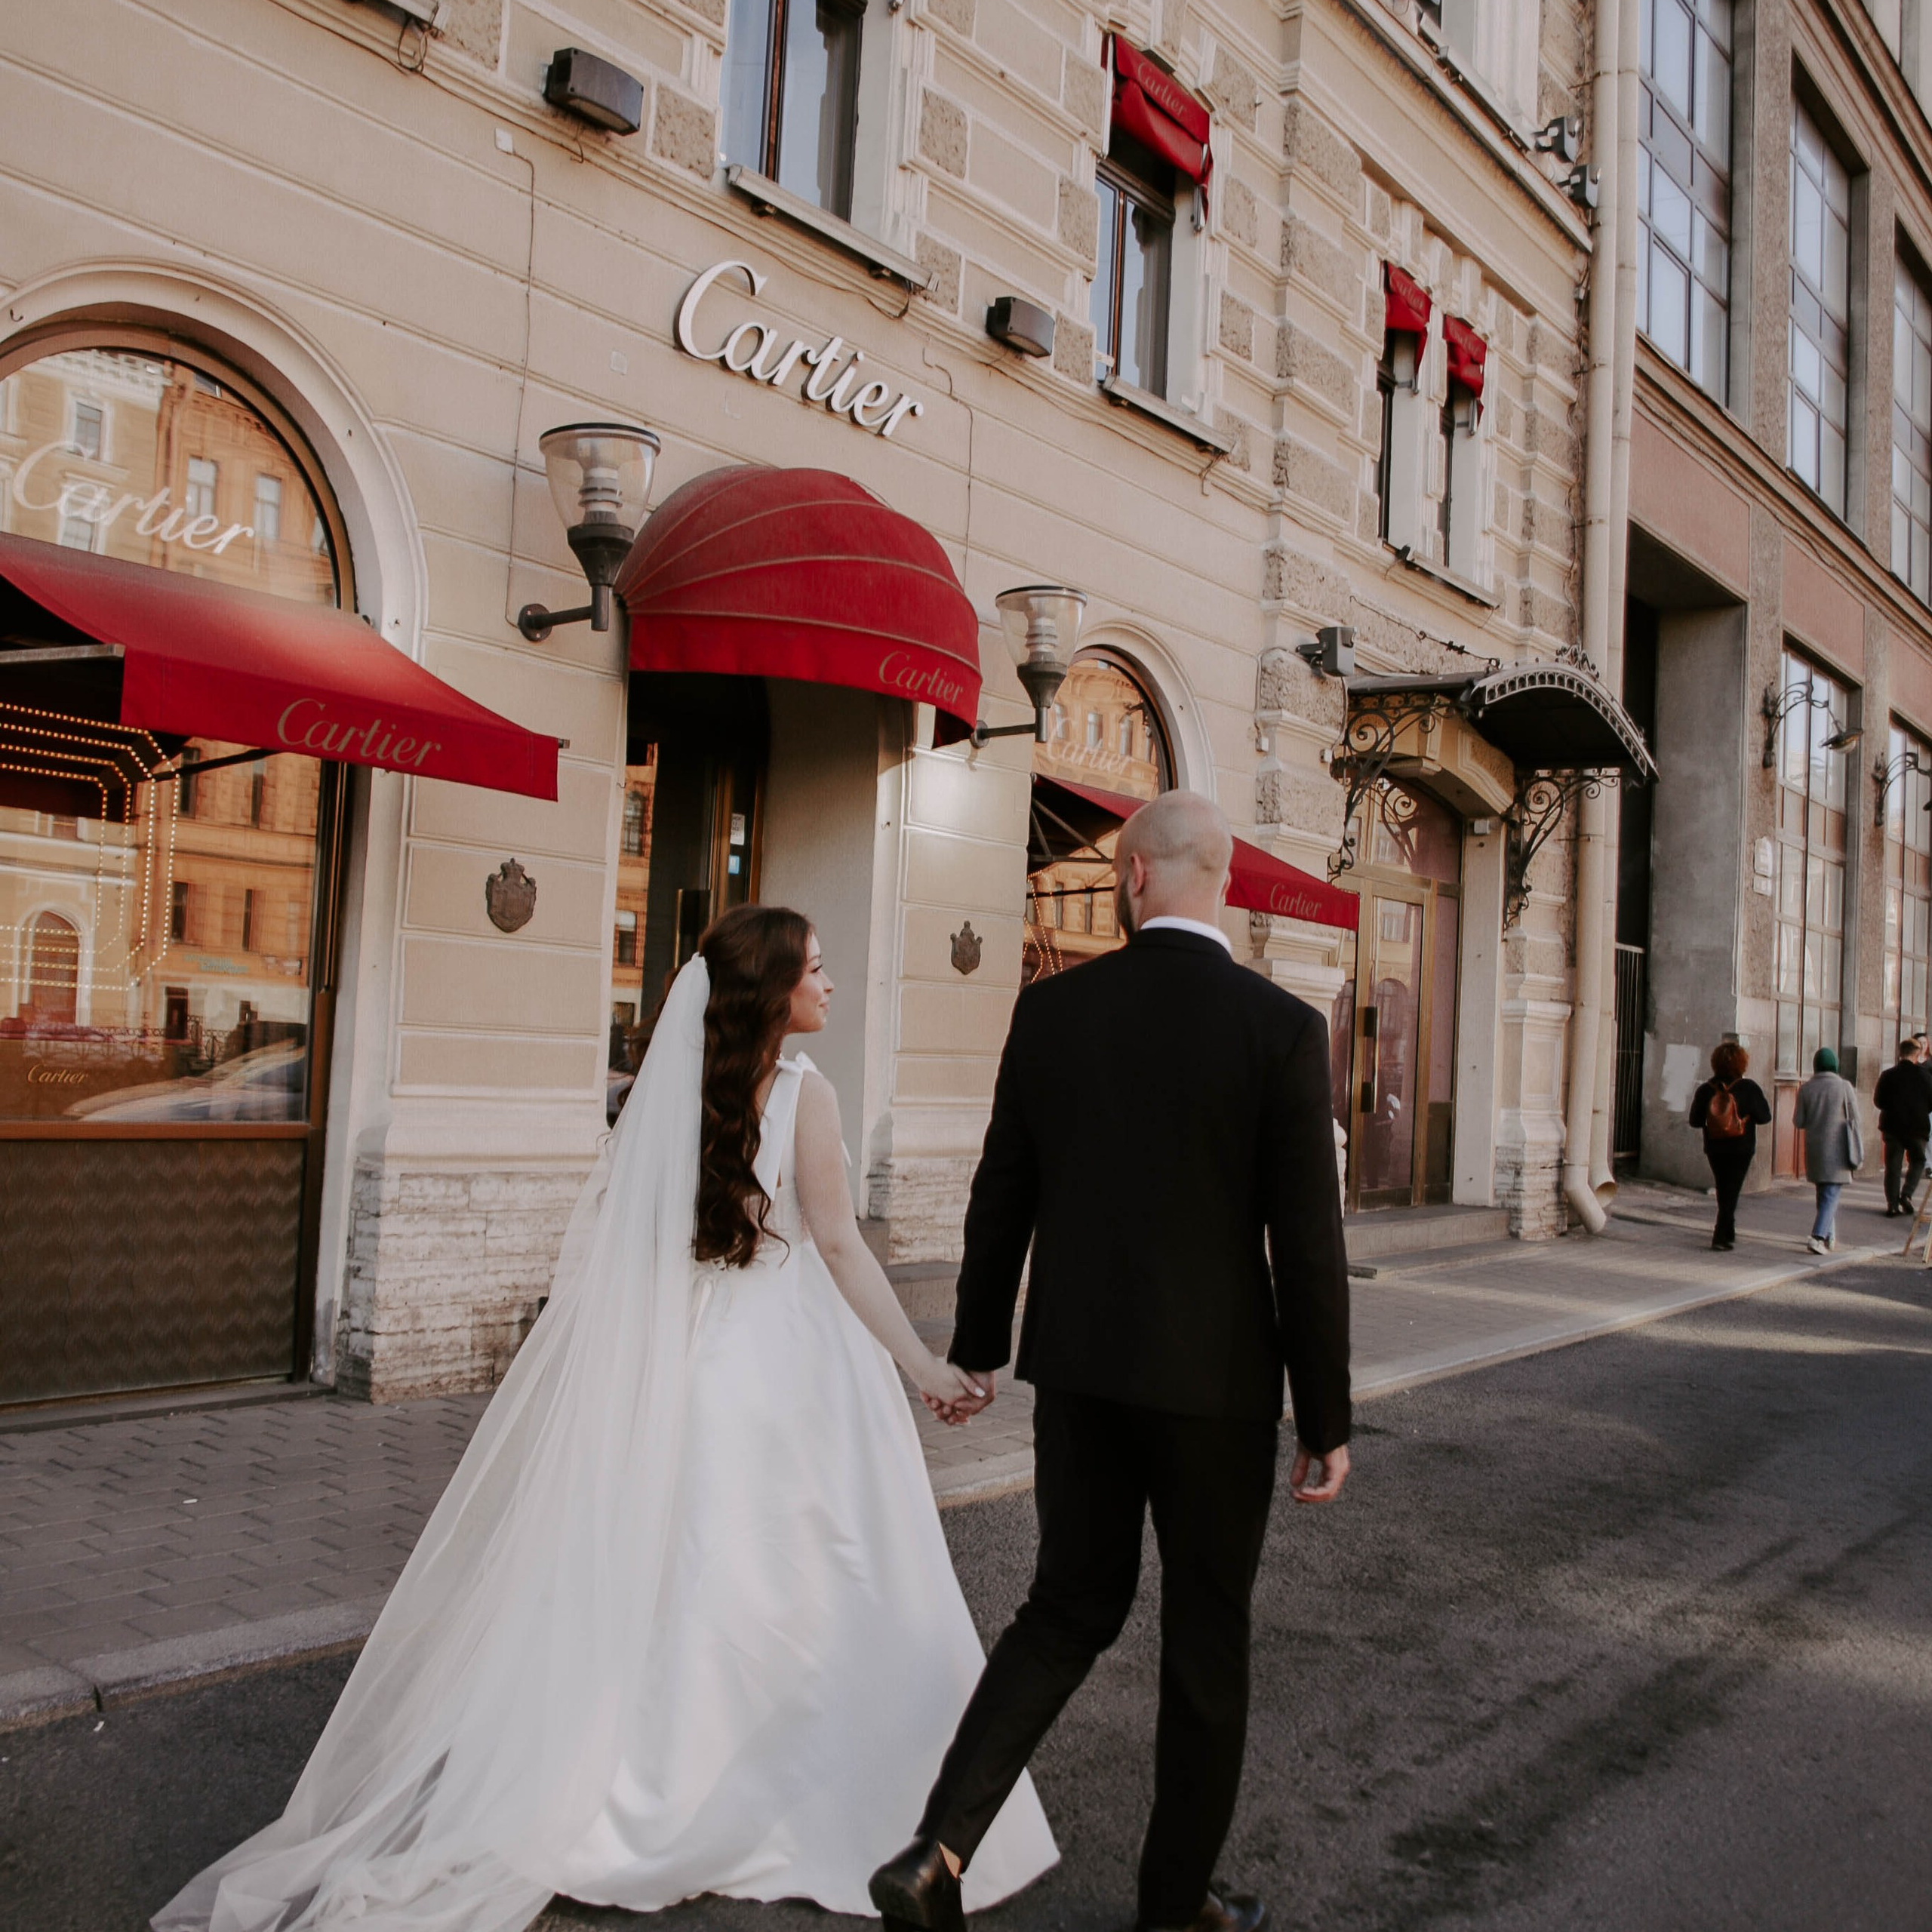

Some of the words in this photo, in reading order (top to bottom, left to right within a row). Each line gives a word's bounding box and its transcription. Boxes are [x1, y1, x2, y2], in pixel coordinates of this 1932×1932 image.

[1138, 61, 1187, 116] Cartier
[675, 260, 924, 437] Cartier
[13, 440, 254, 554] Cartier
[878, 651, 964, 703] Cartier
[276, 697, 441, 767] Cartier
[1046, 718, 1134, 775] Cartier
[1270, 882, 1321, 918] Cartier
[27, 1058, 89, 1084] Cartier
